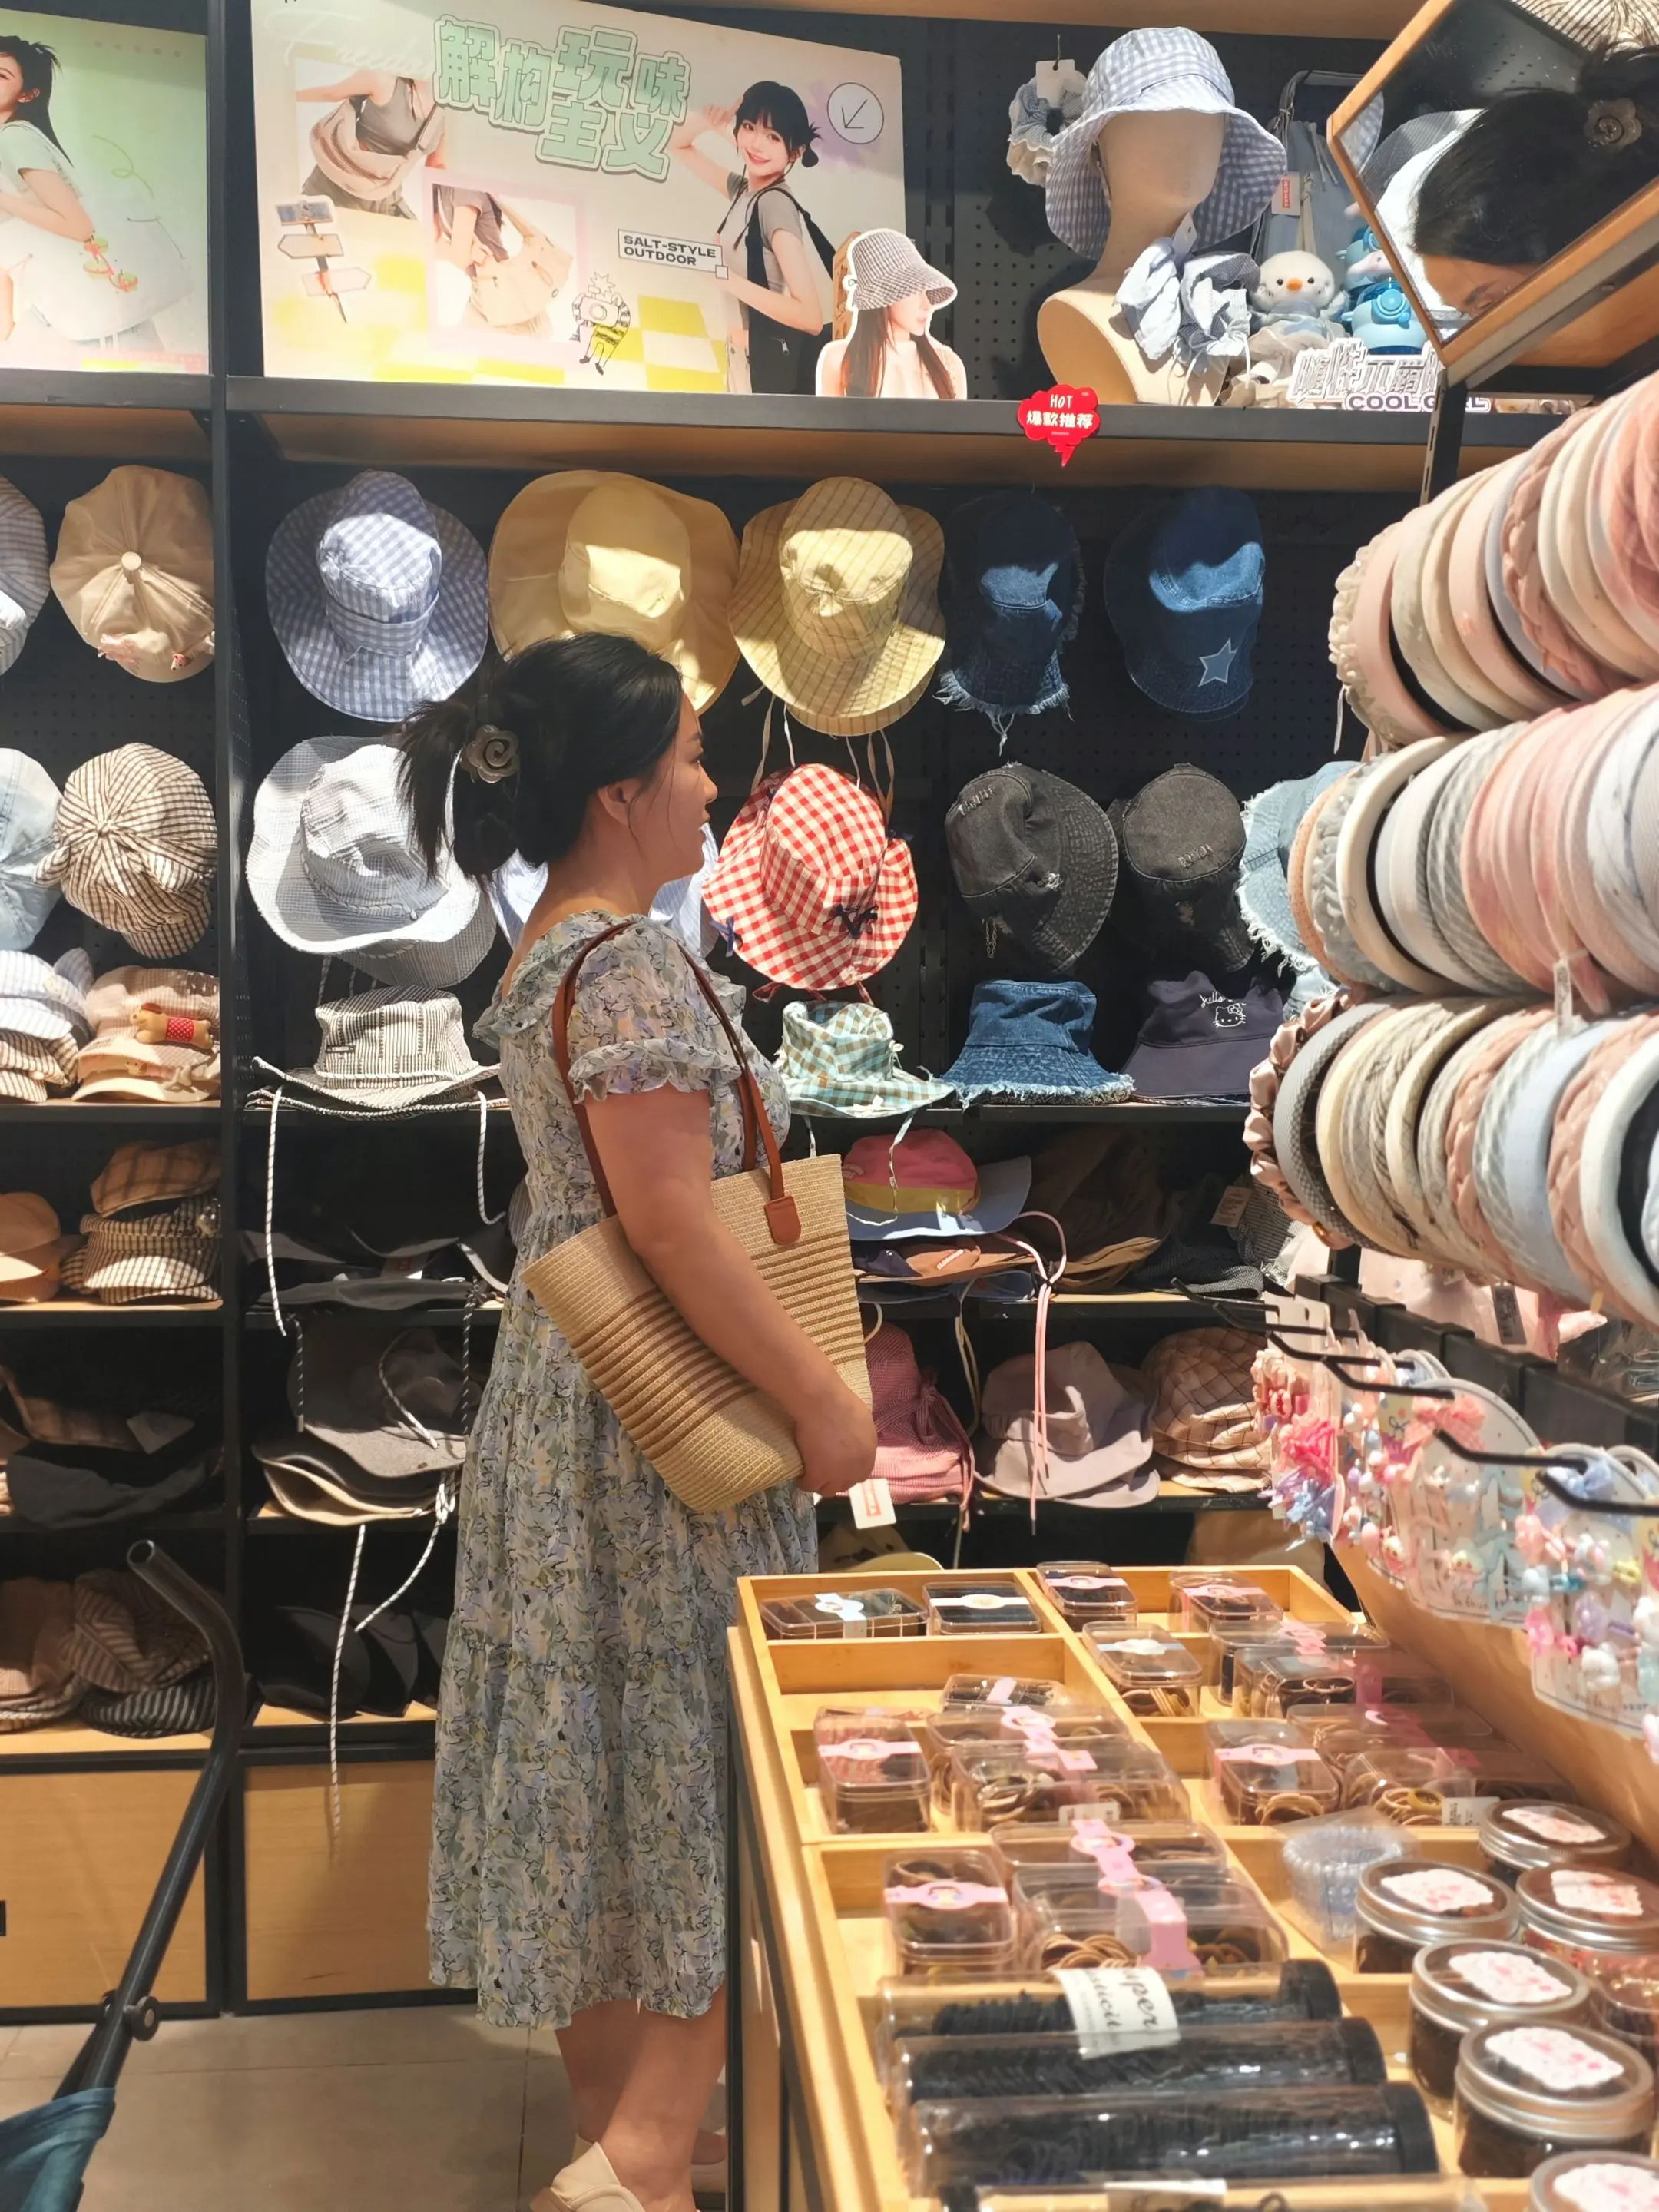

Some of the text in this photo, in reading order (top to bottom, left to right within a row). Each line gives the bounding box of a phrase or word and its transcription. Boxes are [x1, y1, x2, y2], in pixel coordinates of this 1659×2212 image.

[436, 17, 688, 127] 解构玩味
[539, 101, 673, 177] 主义
[624, 234, 717, 258] SALT-STYLE
[624, 247, 697, 266] OUTDOOR
[1050, 393, 1074, 409] HOT
[1349, 395, 1419, 409] COOL
[1026, 409, 1094, 429] 爆款推荐
